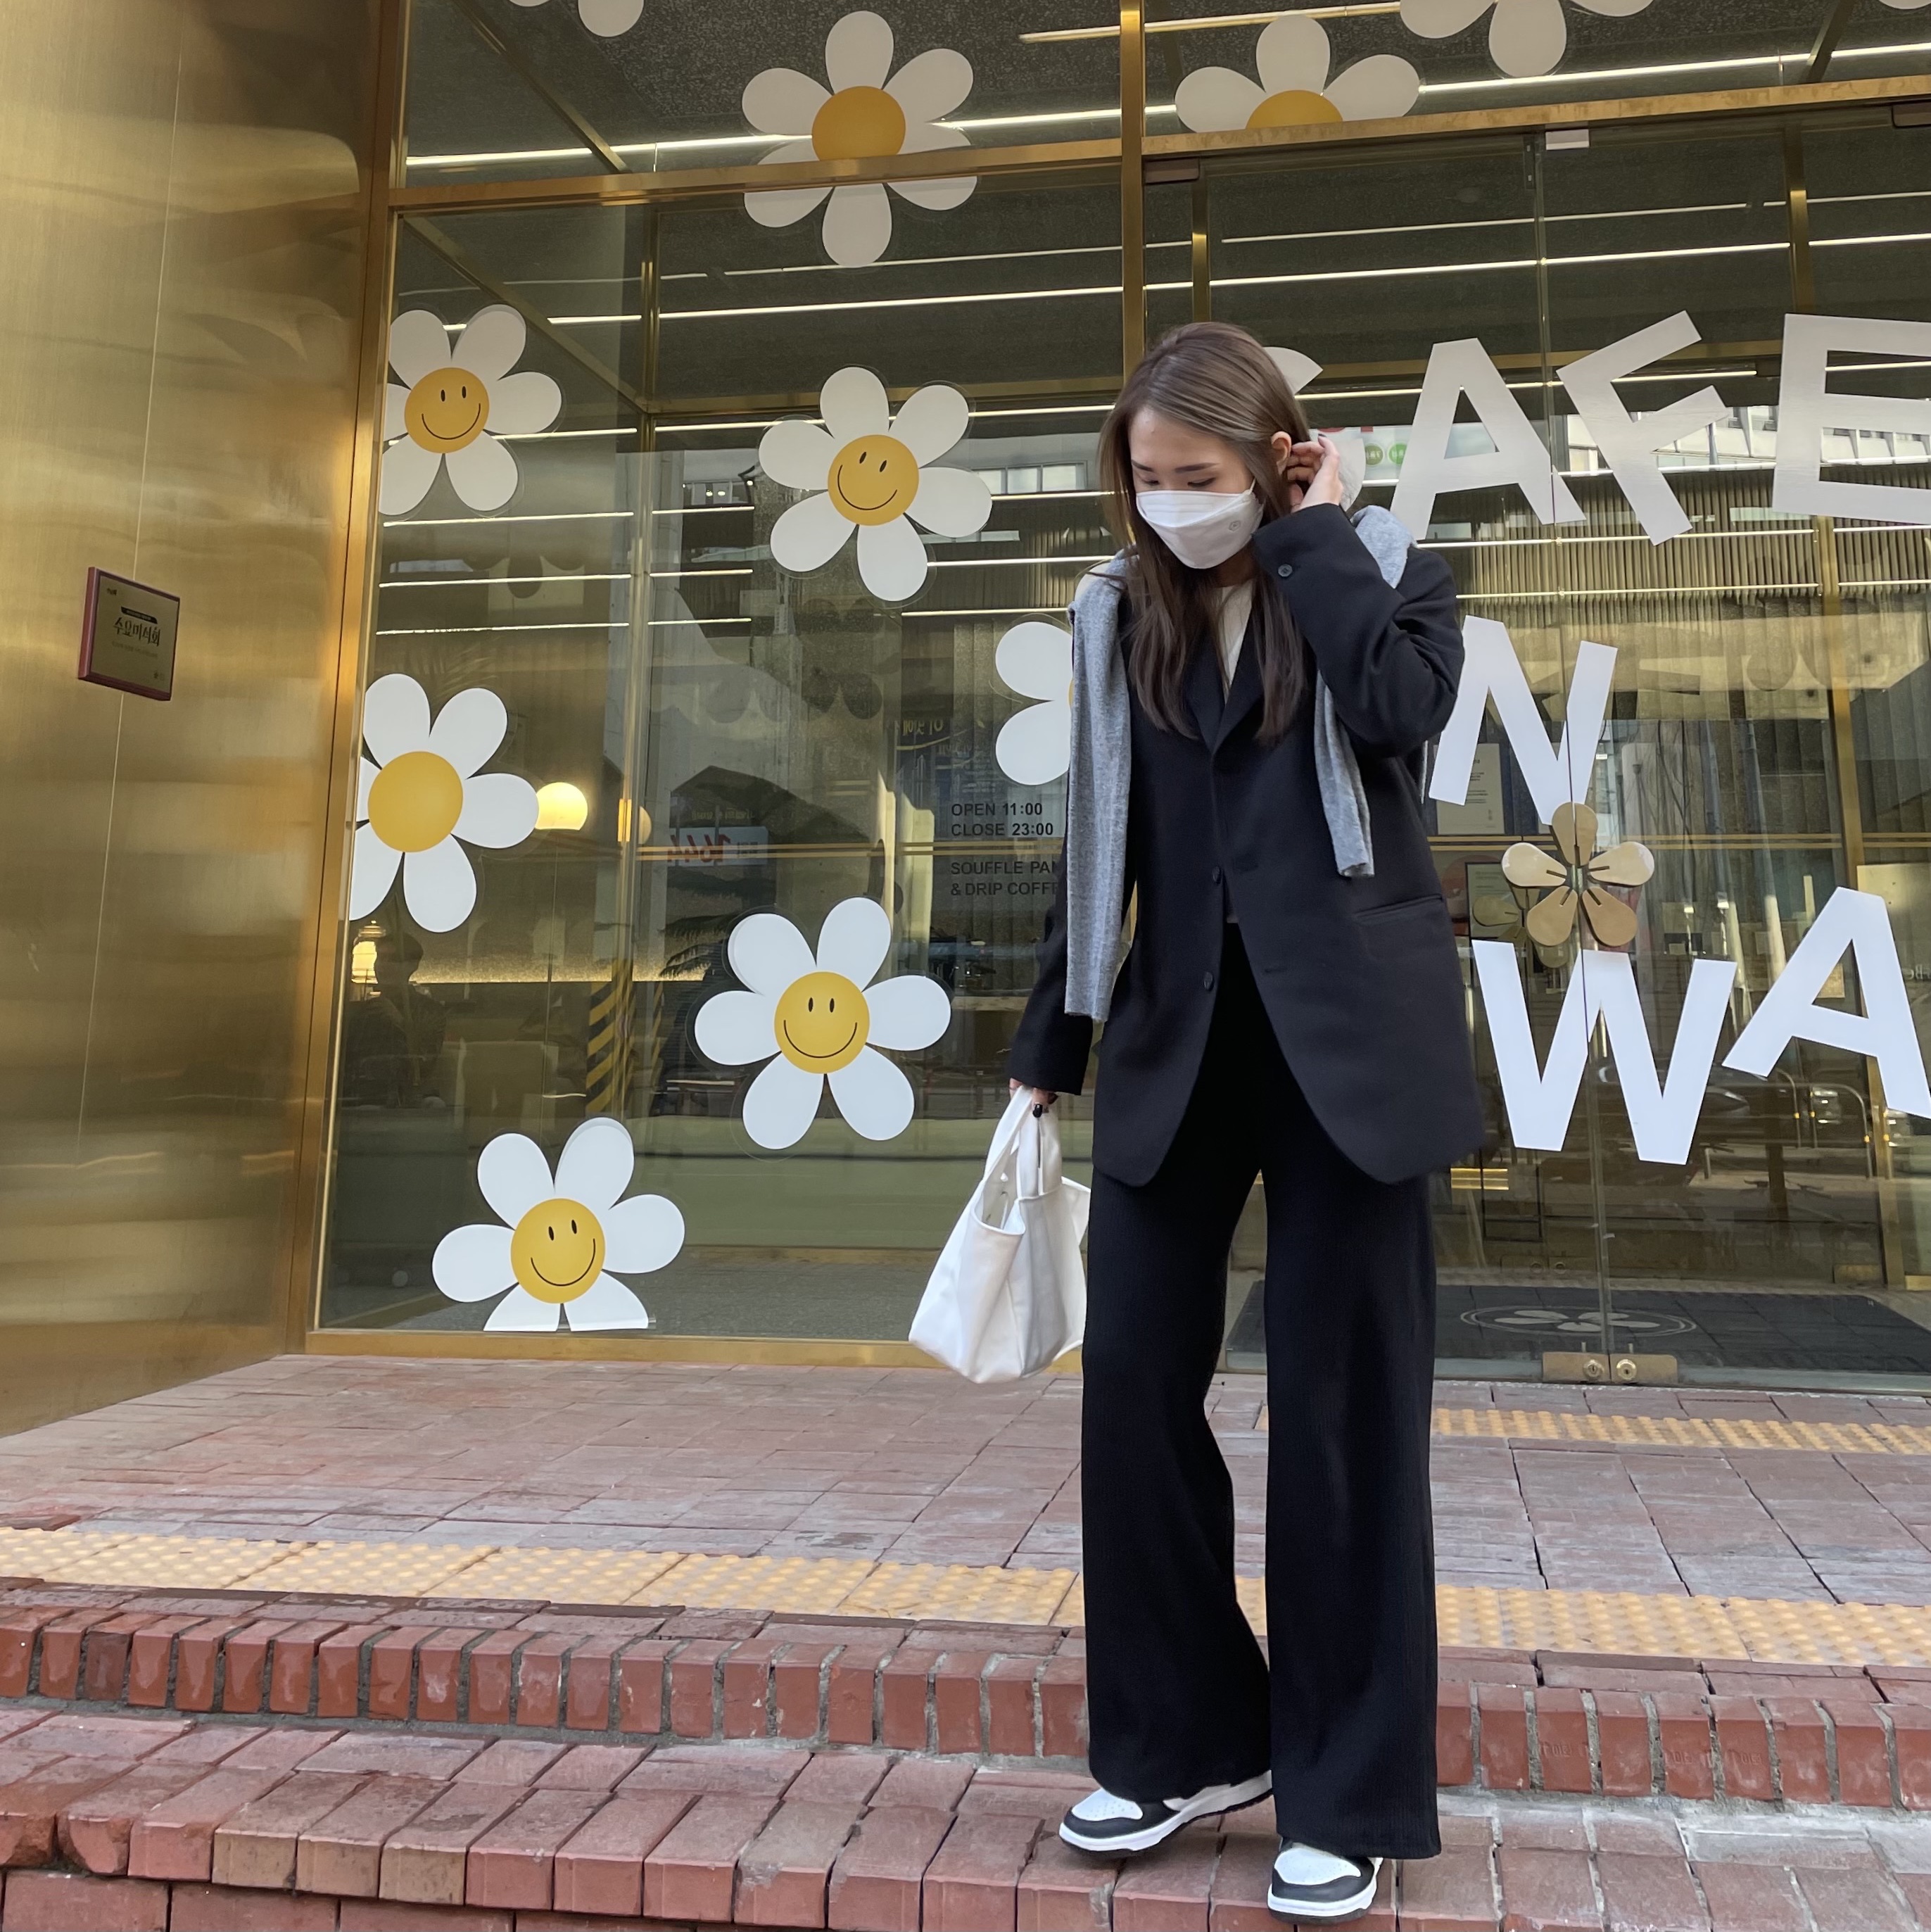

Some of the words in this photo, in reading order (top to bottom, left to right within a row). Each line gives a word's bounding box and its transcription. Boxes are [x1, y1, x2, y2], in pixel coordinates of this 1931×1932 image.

[951, 803, 996, 816] OPEN
[1002, 802, 1043, 816] 11:00
[951, 823, 1006, 837] CLOSE
[1012, 822, 1053, 836] 23:00
[951, 861, 1023, 875] SOUFFLE
[951, 883, 961, 896] &
[965, 882, 1003, 896] DRIP
